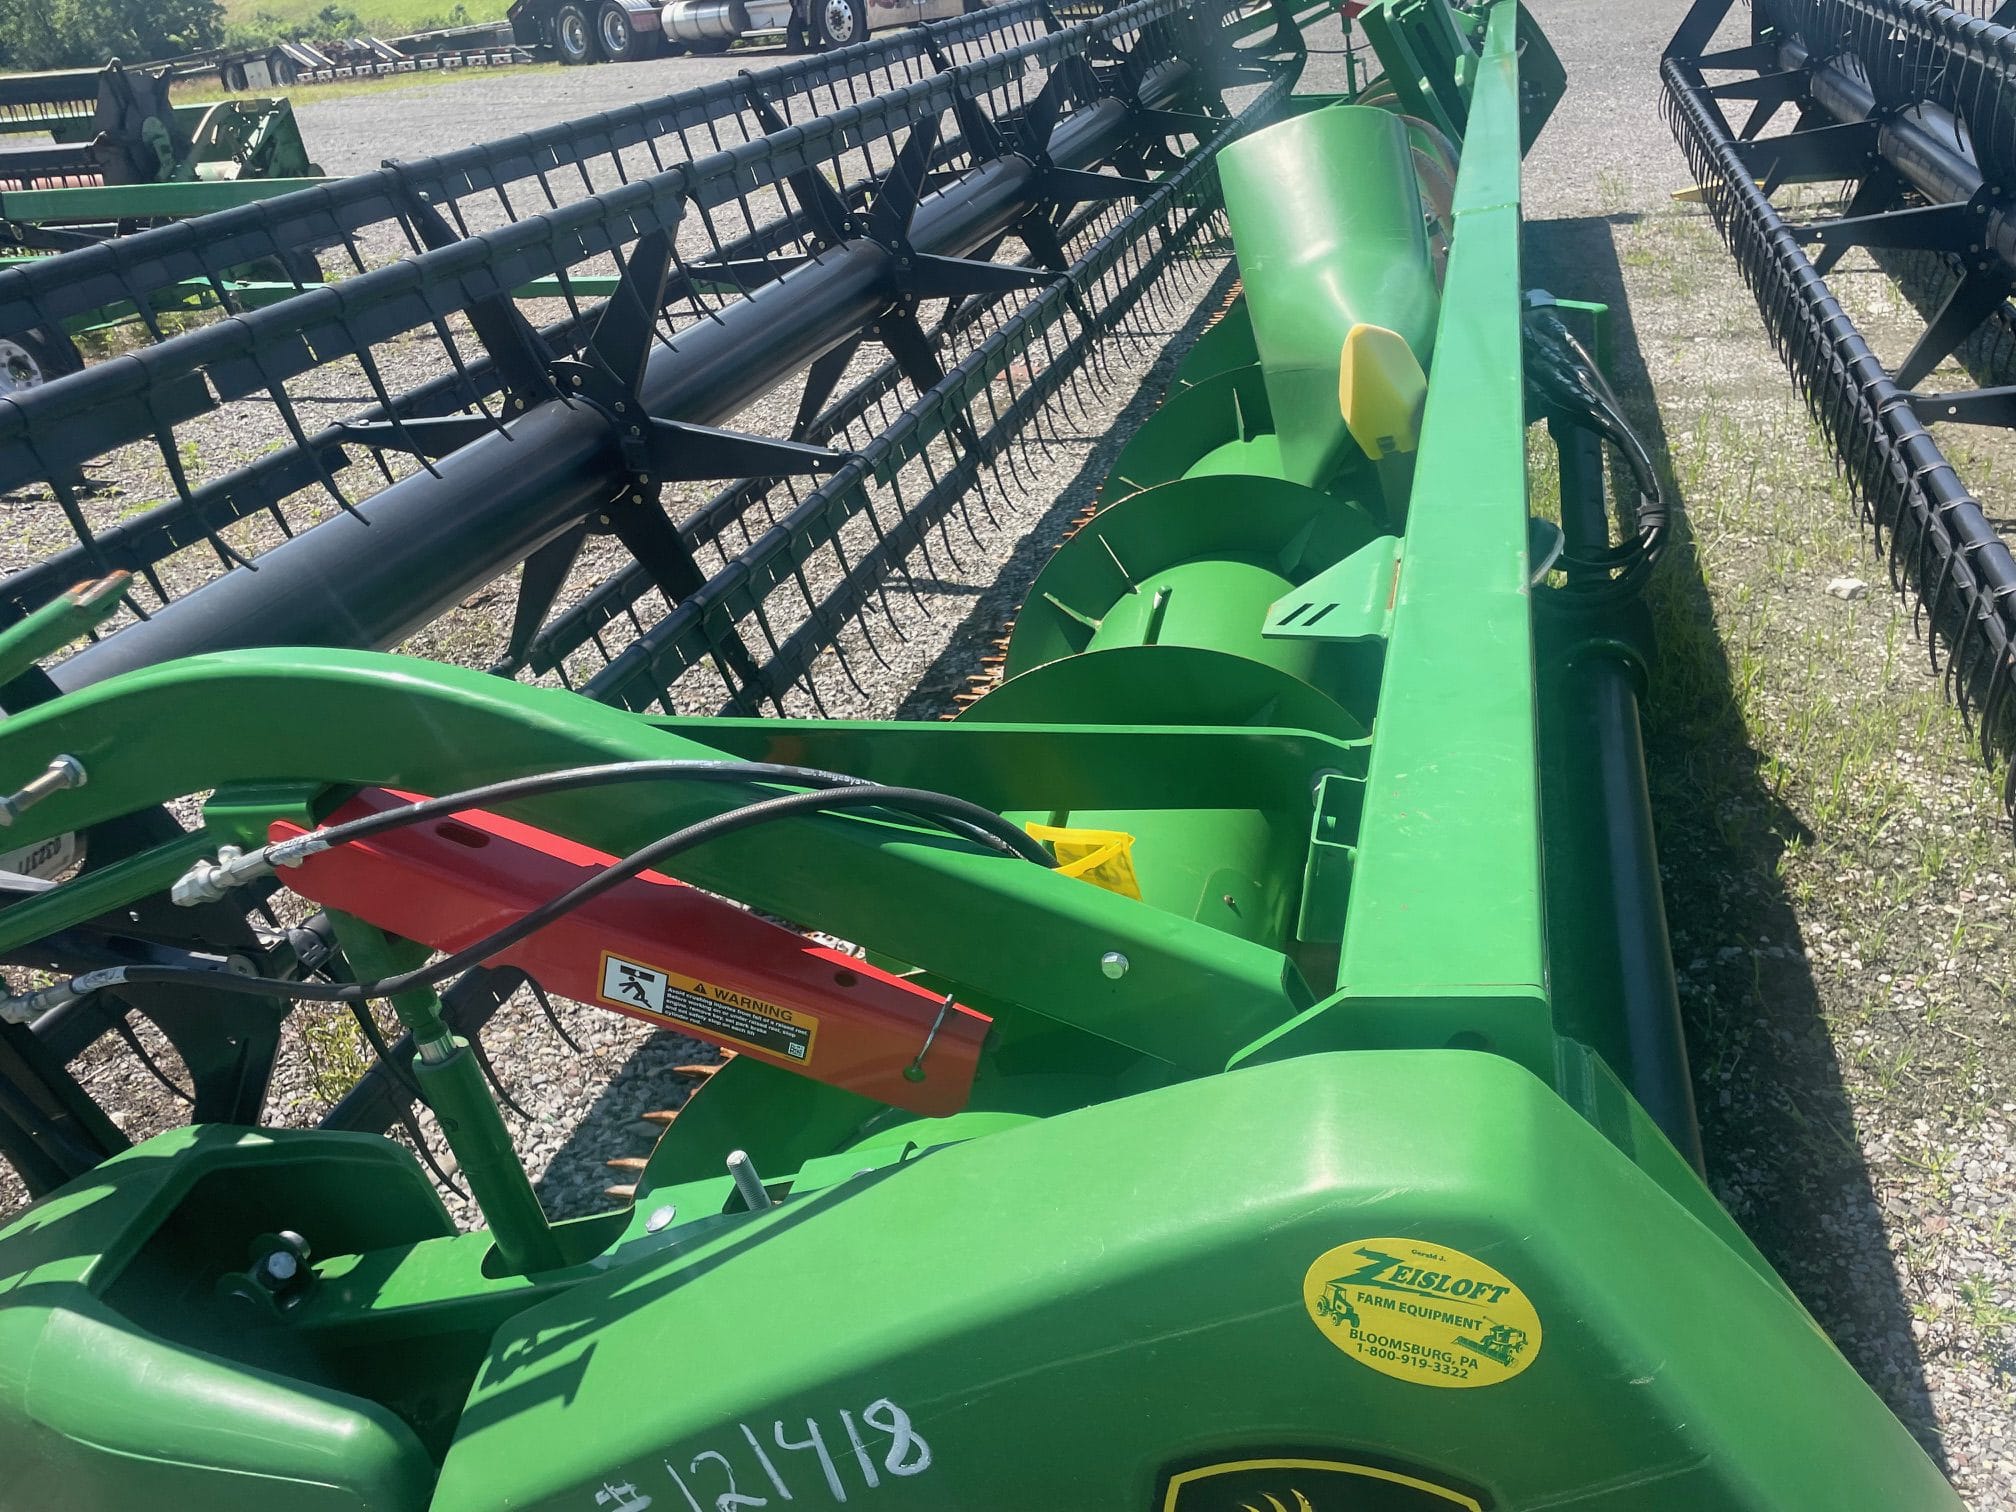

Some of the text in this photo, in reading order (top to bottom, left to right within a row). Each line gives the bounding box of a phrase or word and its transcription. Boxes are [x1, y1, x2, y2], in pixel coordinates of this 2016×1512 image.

[714, 987, 793, 1022] WARNING
[1411, 1249, 1437, 1260] Gerald
[1328, 1247, 1510, 1304] ZEISLOFT
[1357, 1291, 1483, 1331] FARM EQUIPMENT
[1349, 1328, 1479, 1370] BLOOMSBURG, PA
[1356, 1343, 1469, 1379] 1-800-919-3322
